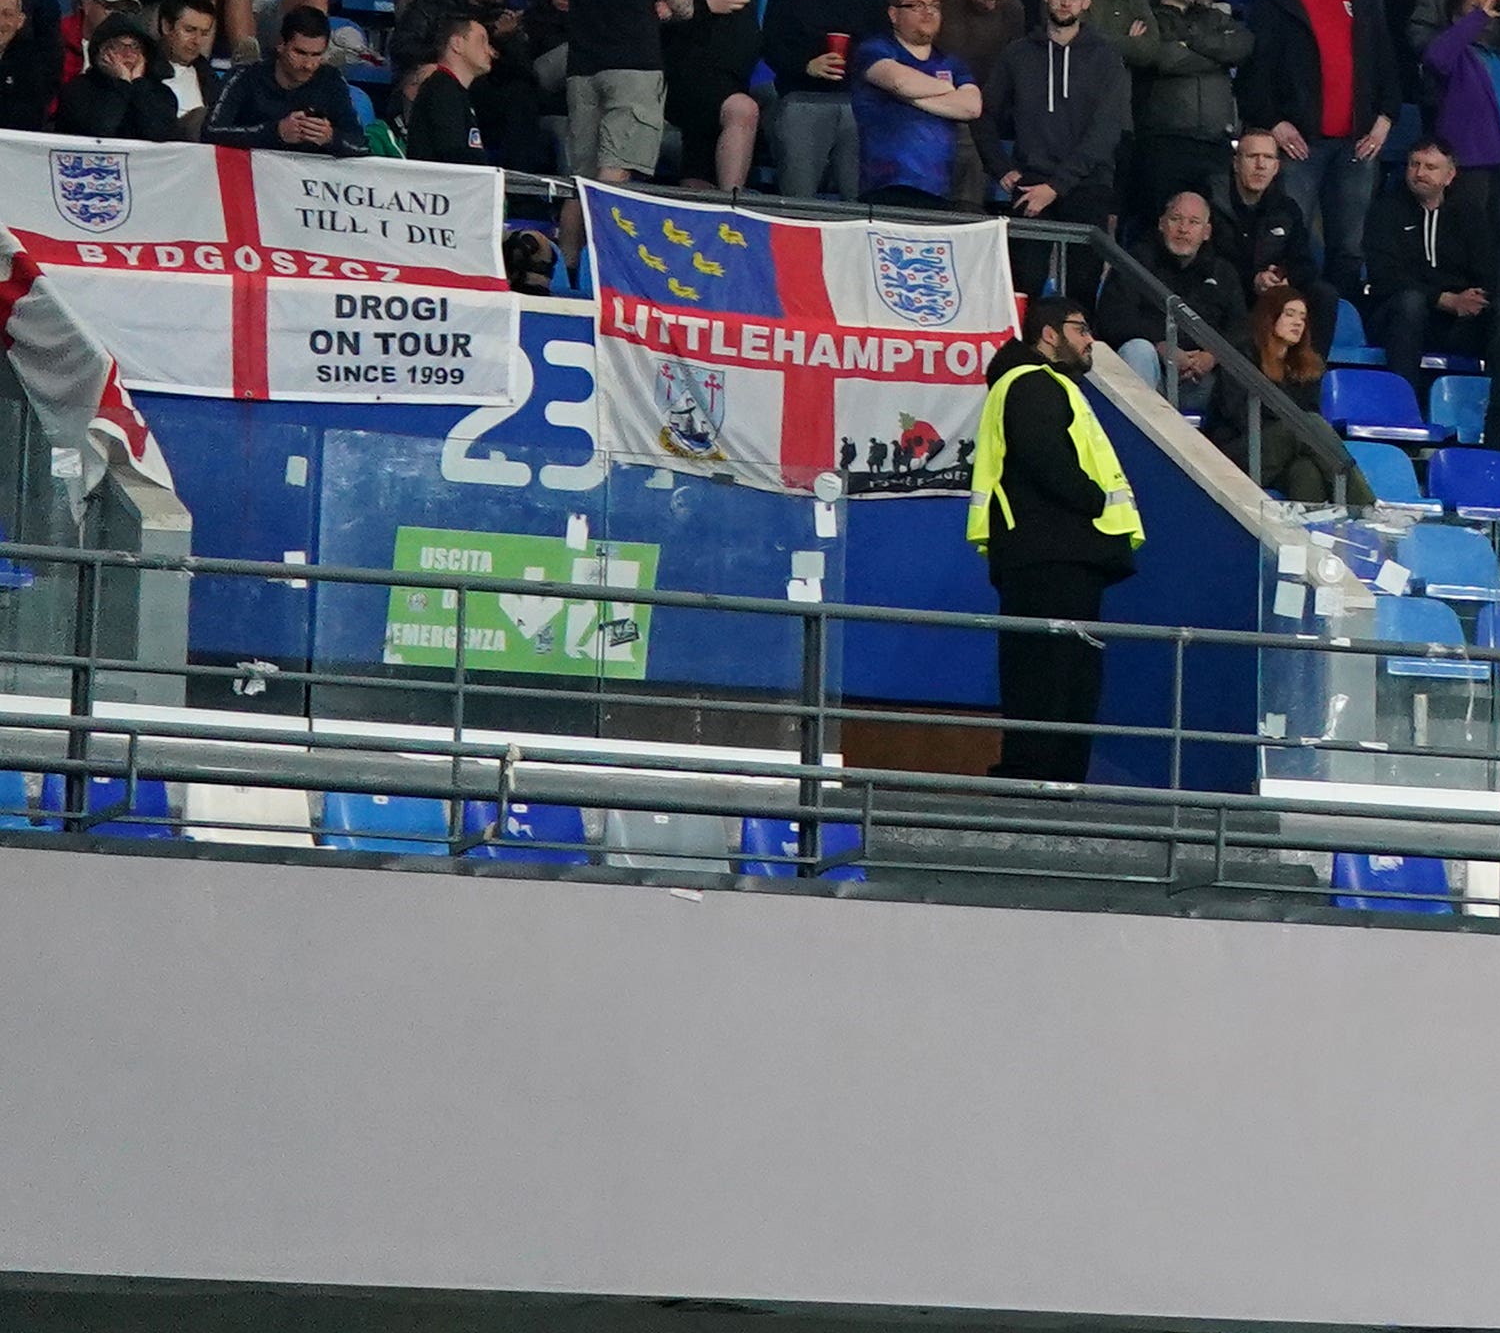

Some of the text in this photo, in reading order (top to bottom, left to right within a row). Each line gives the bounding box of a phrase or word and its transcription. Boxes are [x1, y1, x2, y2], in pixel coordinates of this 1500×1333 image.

[301, 178, 451, 217] ENGLAND
[294, 207, 369, 234] TILL
[407, 225, 458, 250] DIE
[76, 243, 401, 282] BYDGOSZCZ
[335, 294, 448, 322] DROGI
[309, 329, 472, 358] ON TOUR
[612, 295, 1006, 376] LITTLEHAMPTON
[316, 364, 465, 384] SINCE 1999
[440, 336, 606, 491] 23
[419, 546, 493, 573] USCITA
